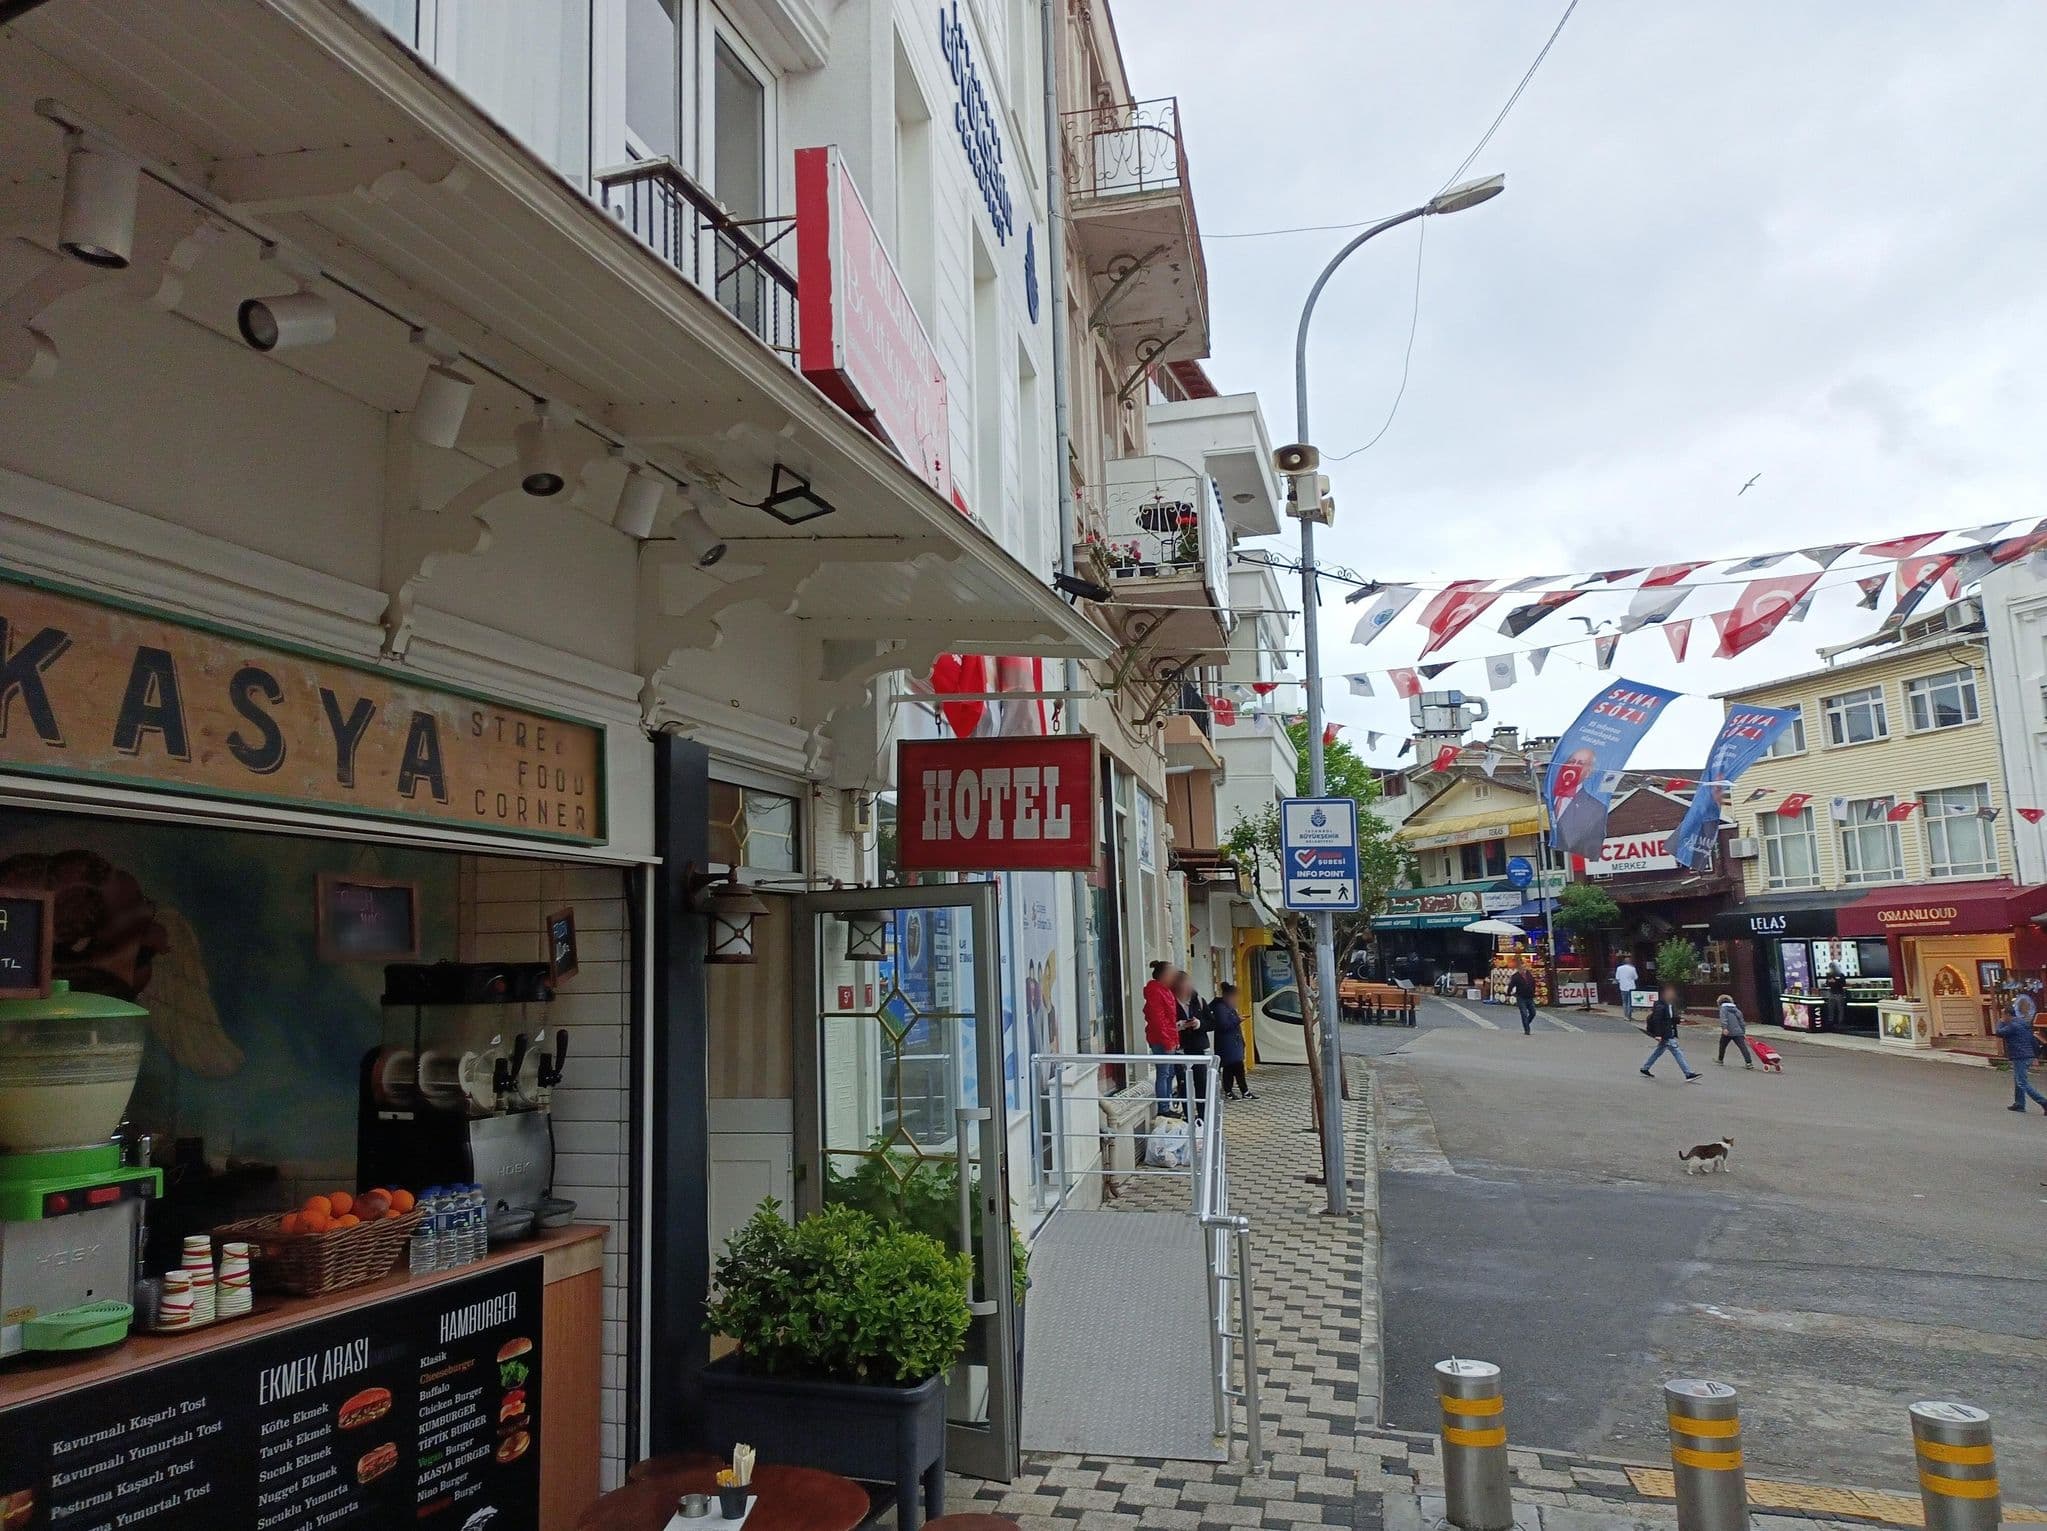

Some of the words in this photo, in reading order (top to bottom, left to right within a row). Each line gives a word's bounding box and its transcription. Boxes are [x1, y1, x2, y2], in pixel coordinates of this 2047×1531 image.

[1593, 700, 1645, 725] SÖZ!
[1607, 688, 1658, 708] SANA
[1729, 713, 1775, 728] SANA
[474, 788, 586, 831] CORNER
[921, 766, 1071, 841] HOTEL
[1318, 857, 1346, 866] ŞUBESİ
[1600, 839, 1670, 862] CZANE
[1611, 861, 1647, 871] MERKEZ
[1296, 870, 1318, 878] INFO
[1318, 870, 1345, 878] POINT
[1750, 915, 1787, 931] LELAS
[1928, 906, 1958, 919] OUD
[440, 1291, 517, 1345] HAMBURGER
[259, 1353, 318, 1406] EKMEK
[322, 1337, 369, 1384] ARASI
[420, 1351, 447, 1368] Klasik
[419, 1383, 450, 1401] Buffalo
[419, 1399, 453, 1418] Chicken
[454, 1386, 483, 1405] Burger
[51, 1422, 126, 1456] Kavurmalı
[129, 1406, 176, 1430] Kaşarlı
[180, 1396, 207, 1414] Tost
[260, 1417, 290, 1436] Köfte
[293, 1401, 330, 1424] Ekmek
[418, 1403, 476, 1434] KUMBURGER
[418, 1430, 449, 1451] TİFTİK
[451, 1415, 487, 1436] BURGER
[51, 1454, 125, 1488] Kavurmalı
[129, 1431, 194, 1461] Yumurtalı
[196, 1420, 223, 1439] Tost
[260, 1438, 294, 1459] Tavuk
[296, 1424, 332, 1446] Ekmek
[445, 1437, 474, 1456] Burger
[116, 1470, 165, 1497] Kaşarlı
[167, 1458, 195, 1477] Tost
[259, 1462, 294, 1483] Sucuk
[296, 1446, 332, 1468] Ekmek
[417, 1462, 453, 1486] AKASYA
[454, 1444, 490, 1467] BURGER
[257, 1482, 300, 1507] Nugget
[302, 1465, 338, 1487] Ekmek
[417, 1485, 439, 1502] Nino
[440, 1471, 469, 1490] Burger
[454, 1482, 483, 1501] Burger
[116, 1495, 181, 1528] Yumurtalı
[183, 1482, 211, 1501] Tost
[257, 1504, 302, 1531] Sucuklu
[304, 1483, 349, 1509] Yumurta
[316, 1501, 360, 1528] Yumurta
